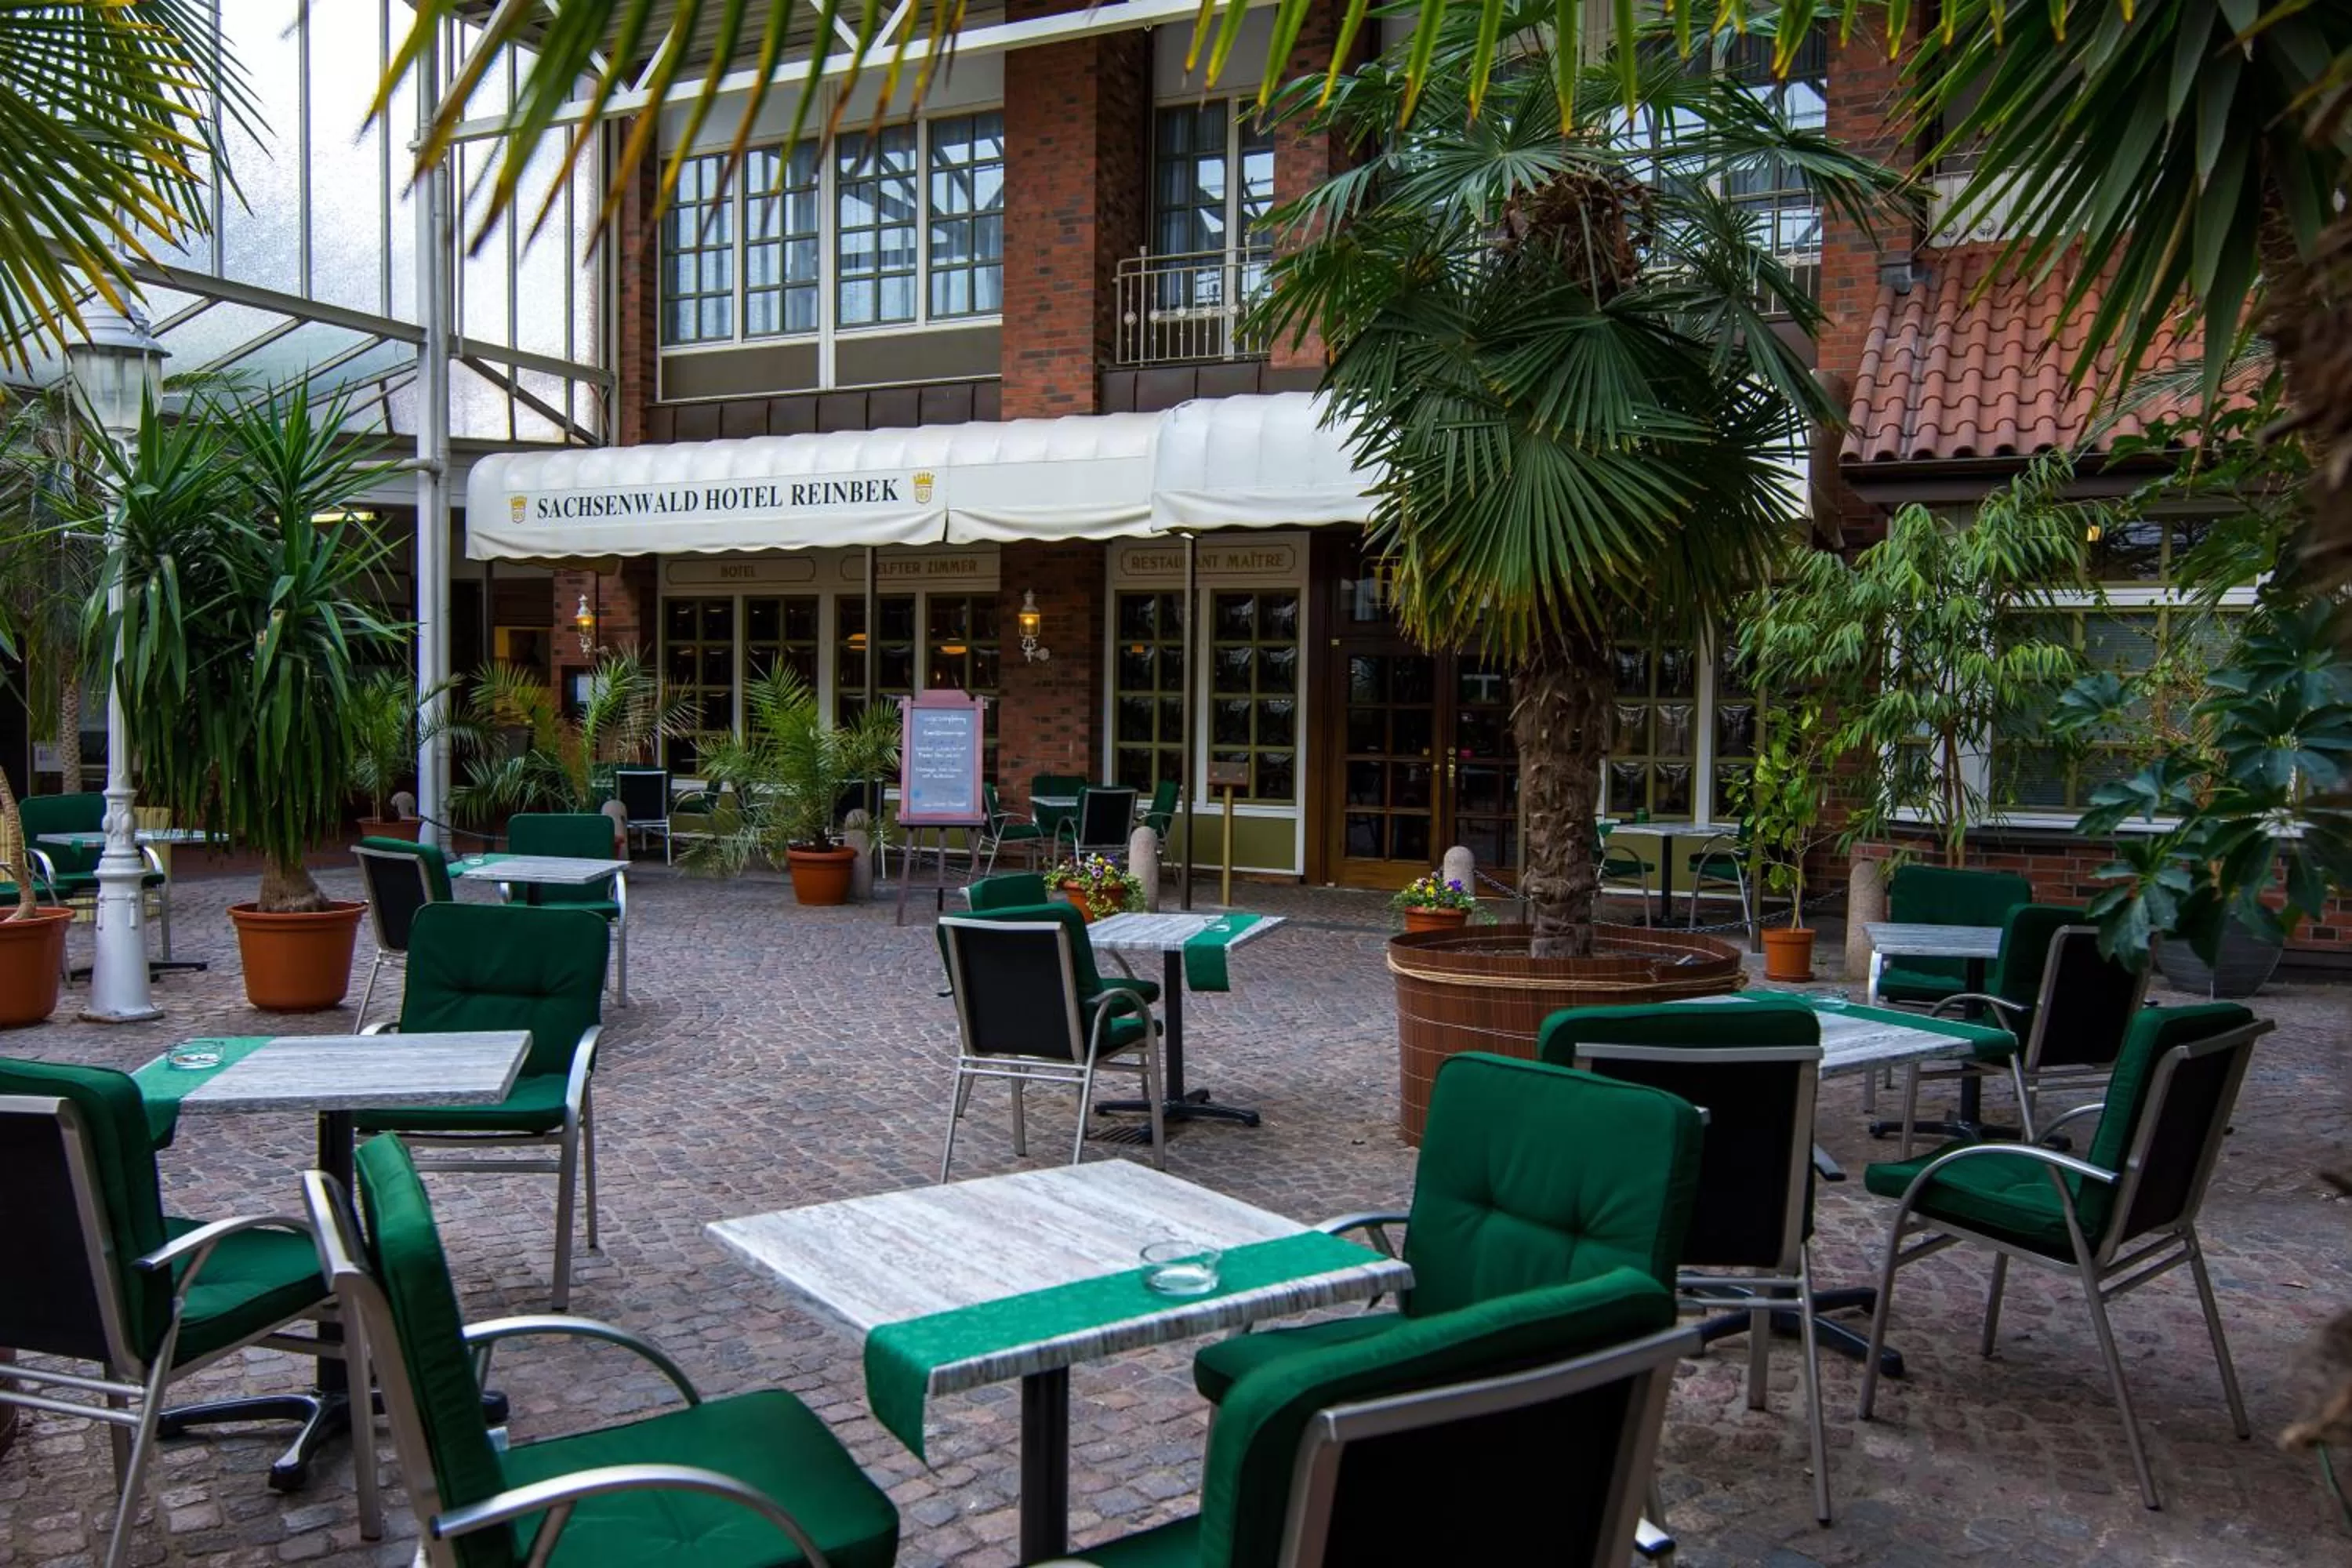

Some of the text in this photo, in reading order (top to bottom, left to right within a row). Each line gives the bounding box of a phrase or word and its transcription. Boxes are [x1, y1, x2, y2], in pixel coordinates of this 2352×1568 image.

[537, 477, 900, 519] SACHSENWALD HOTEL REINBEK
[874, 558, 978, 575] ELFTER ZIMMER
[1131, 554, 1219, 569] RESTAUANT
